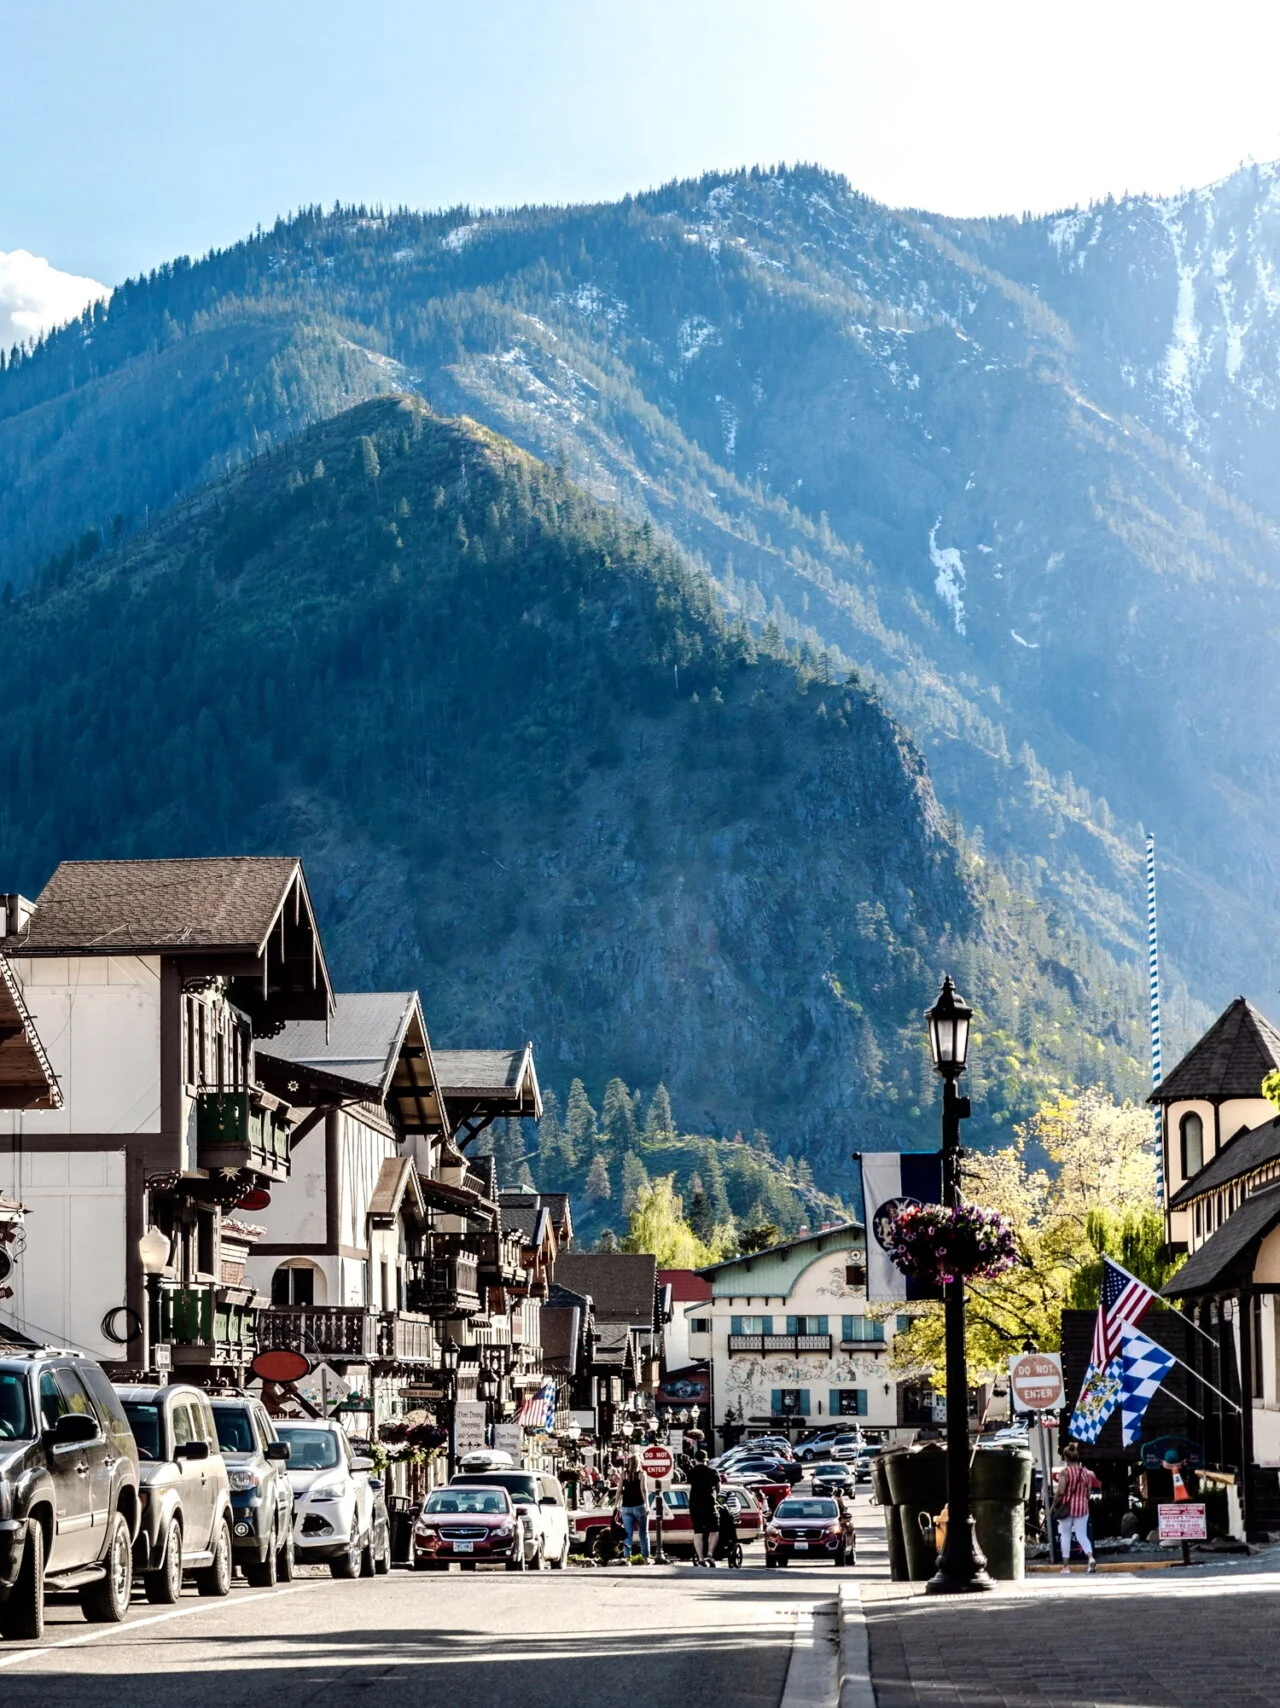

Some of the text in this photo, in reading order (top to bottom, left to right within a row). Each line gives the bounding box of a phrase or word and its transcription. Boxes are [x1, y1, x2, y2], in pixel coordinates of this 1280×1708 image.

[1018, 1364, 1054, 1375] DO NOT
[1024, 1389, 1053, 1399] ENTER
